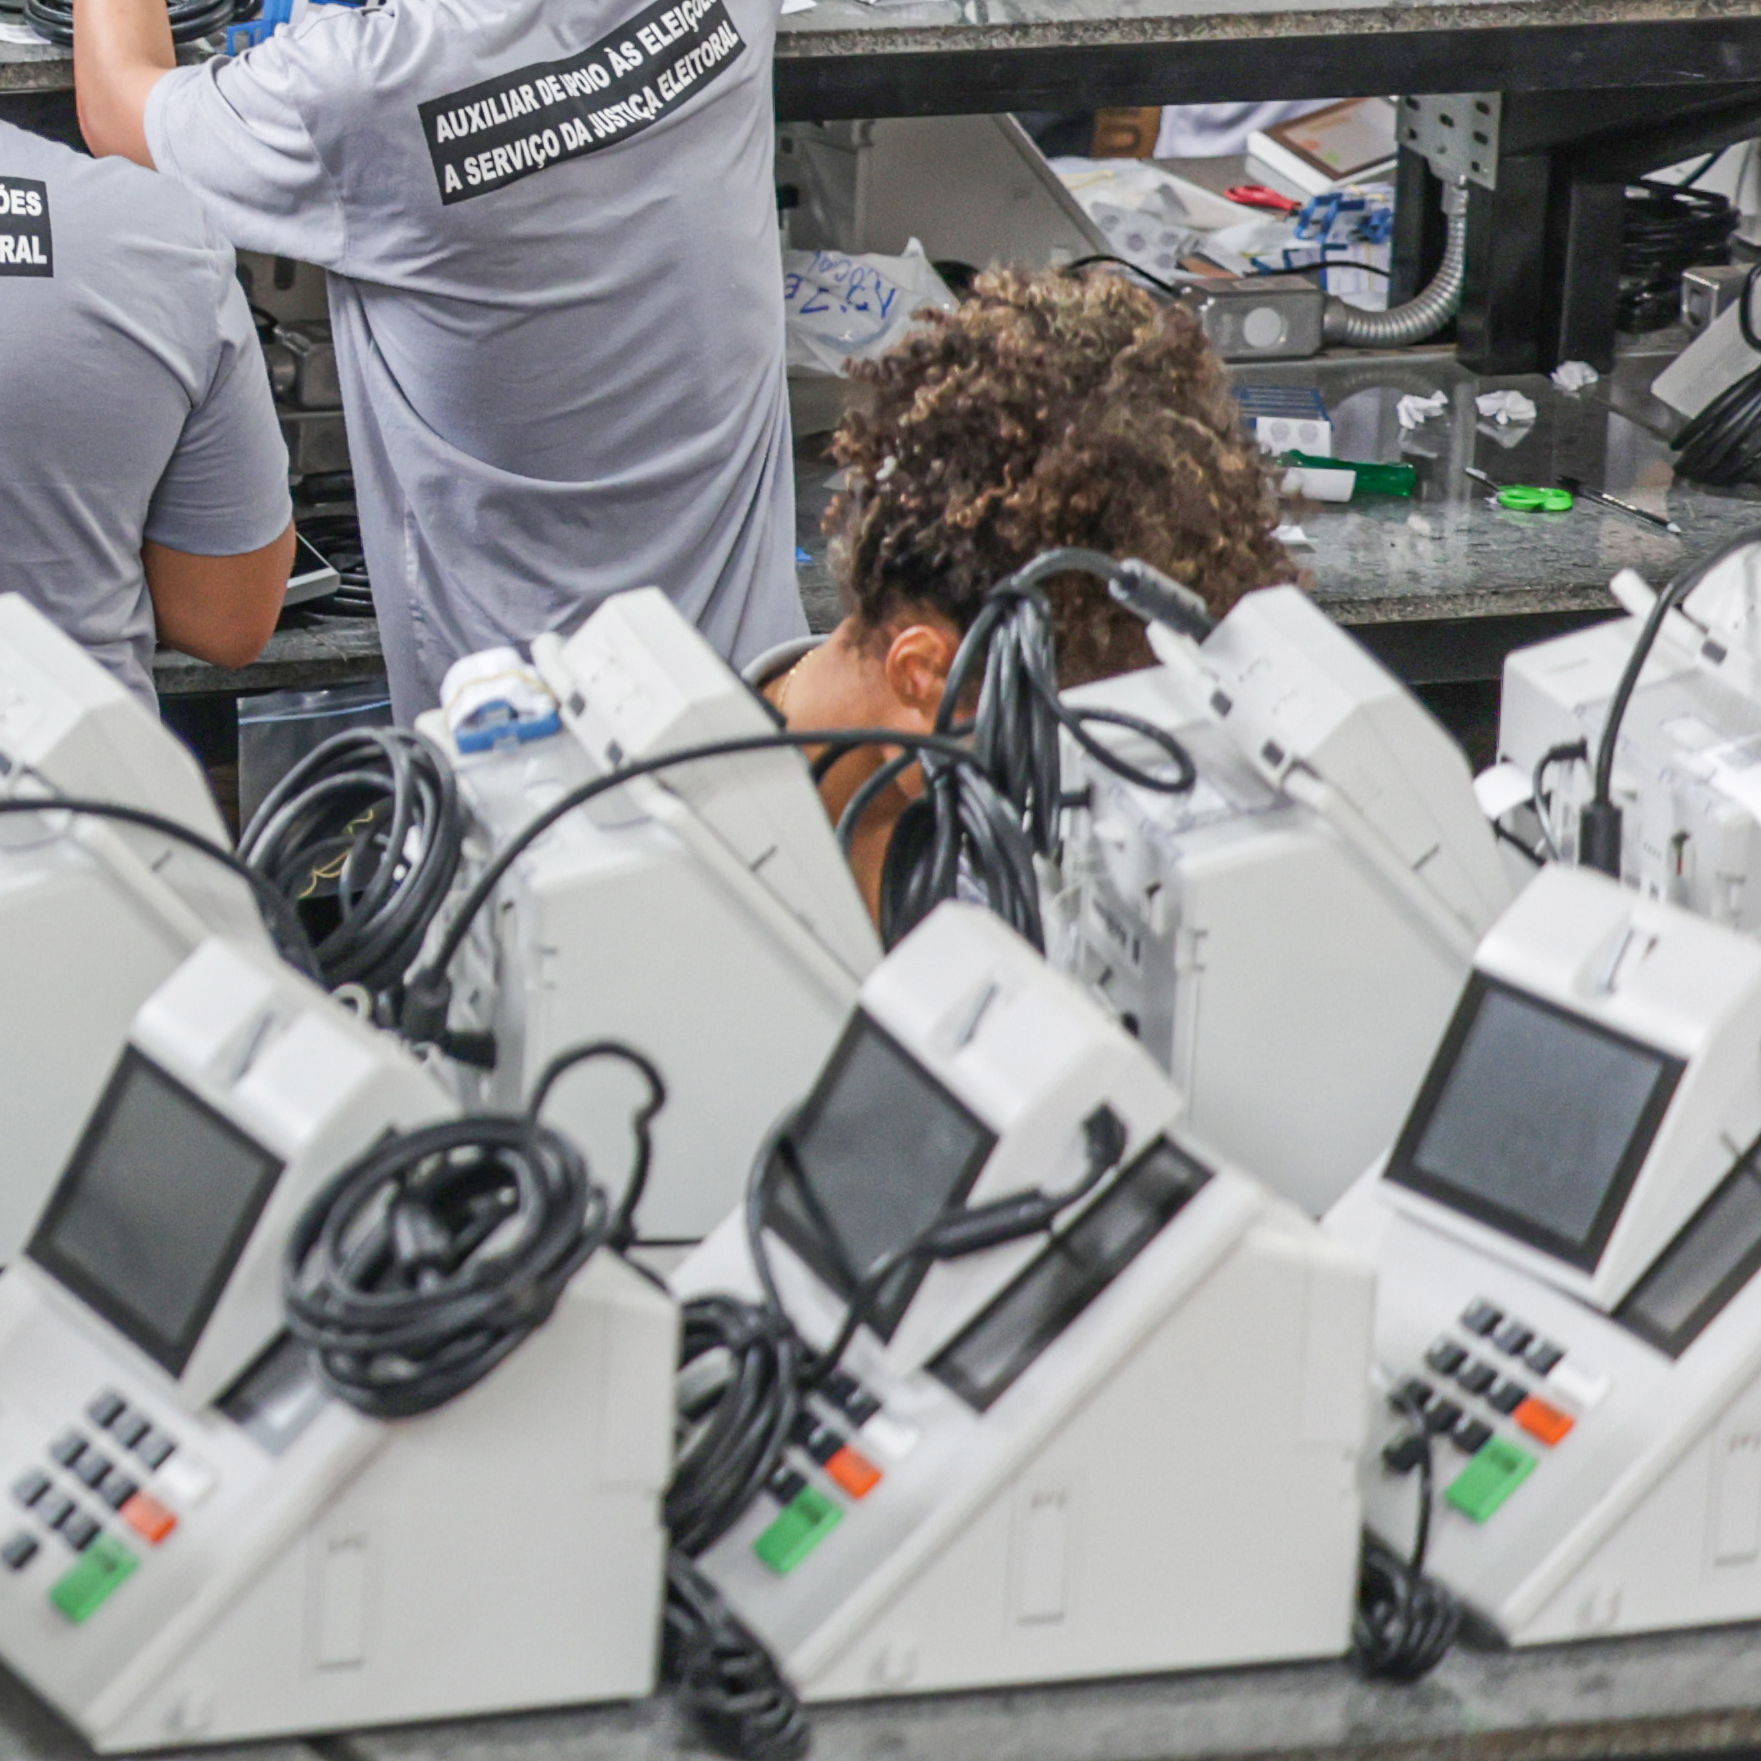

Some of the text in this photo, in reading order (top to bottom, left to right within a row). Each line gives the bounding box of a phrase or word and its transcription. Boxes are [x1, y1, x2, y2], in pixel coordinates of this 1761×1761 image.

[435, 84, 541, 143] AUXILIAR
[540, 75, 567, 107] DE
[606, 43, 644, 78] ÀS
[444, 20, 740, 194] A SERVIÇO DA JUSTIÇA ELEITORAL
